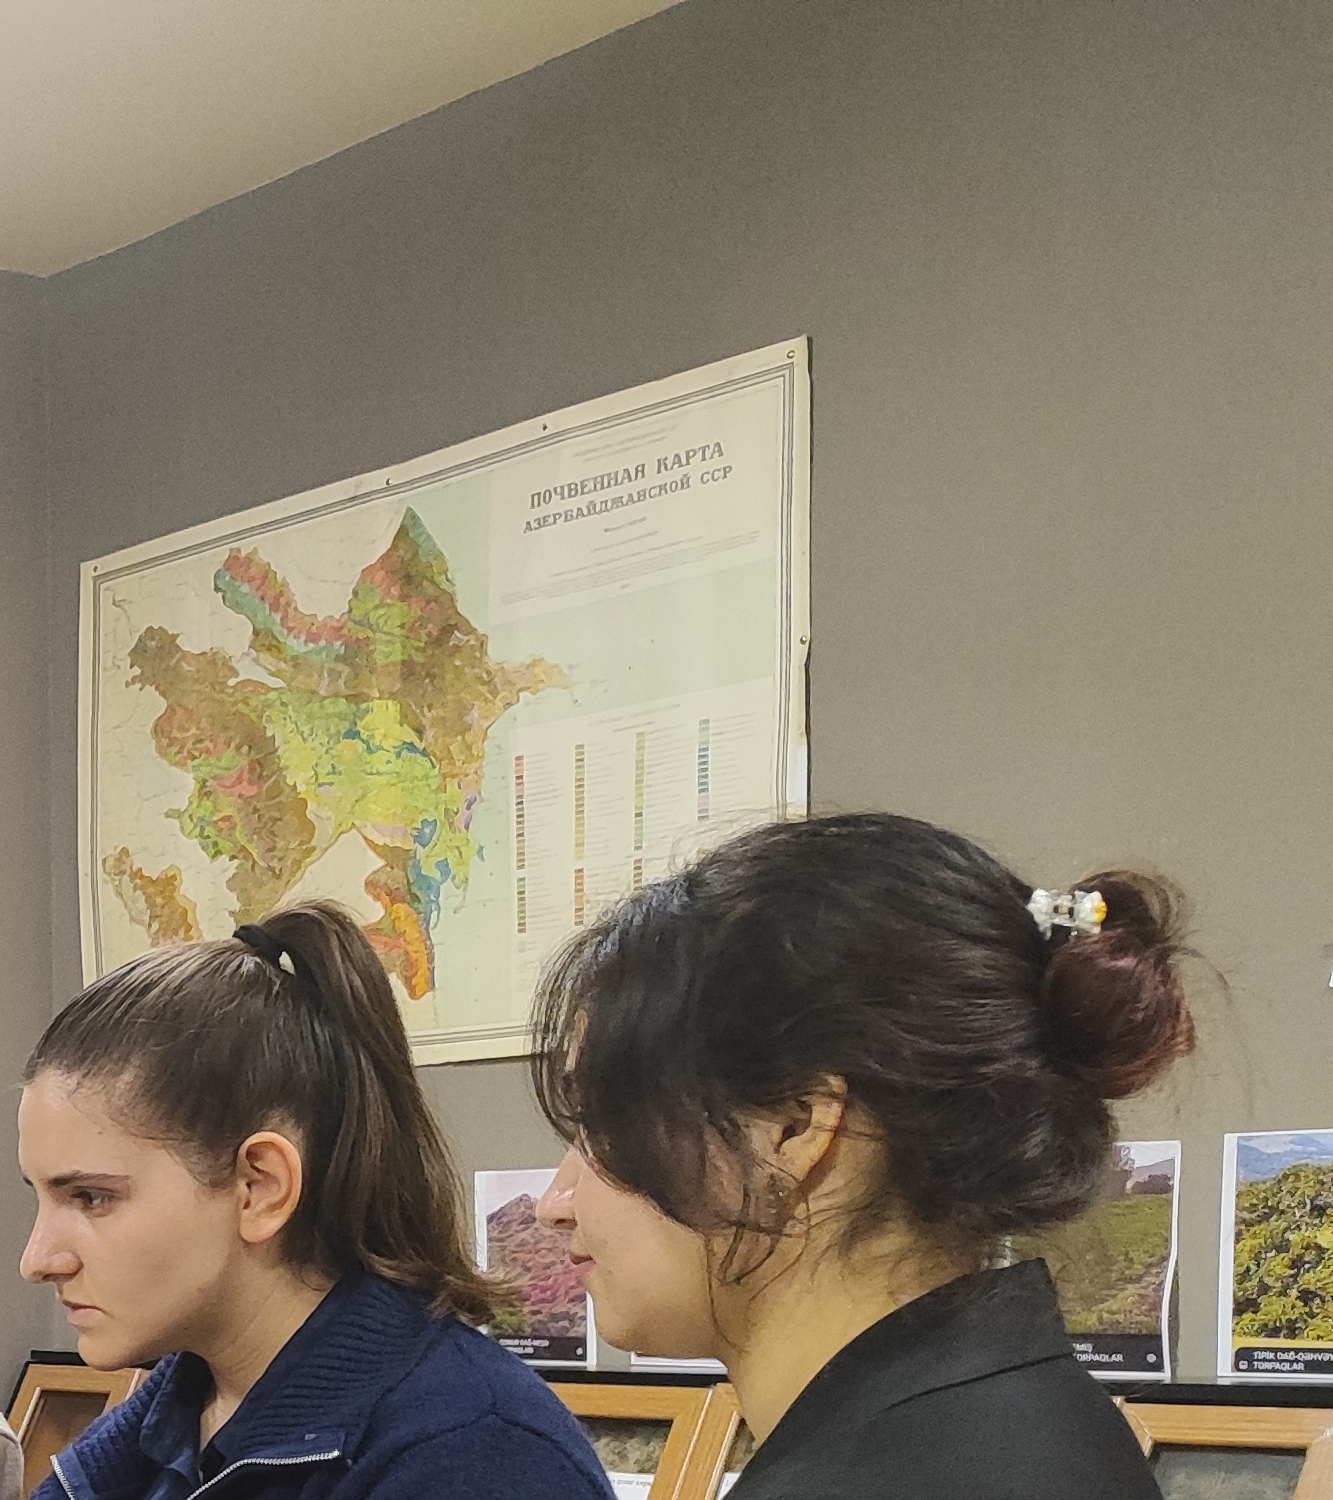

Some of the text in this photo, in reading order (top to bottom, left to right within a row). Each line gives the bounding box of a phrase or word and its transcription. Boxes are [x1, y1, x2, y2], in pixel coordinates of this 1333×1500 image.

[529, 463, 646, 509] ПОЧВЕННАЯ
[656, 441, 724, 475] КАРТА
[523, 473, 691, 534] АЗЕРБАЙДЖАНСКОЙ
[700, 465, 733, 485] ССР
[1073, 1353, 1123, 1362] ORPAQLAR
[1252, 1361, 1305, 1371] TORPAQLAR
